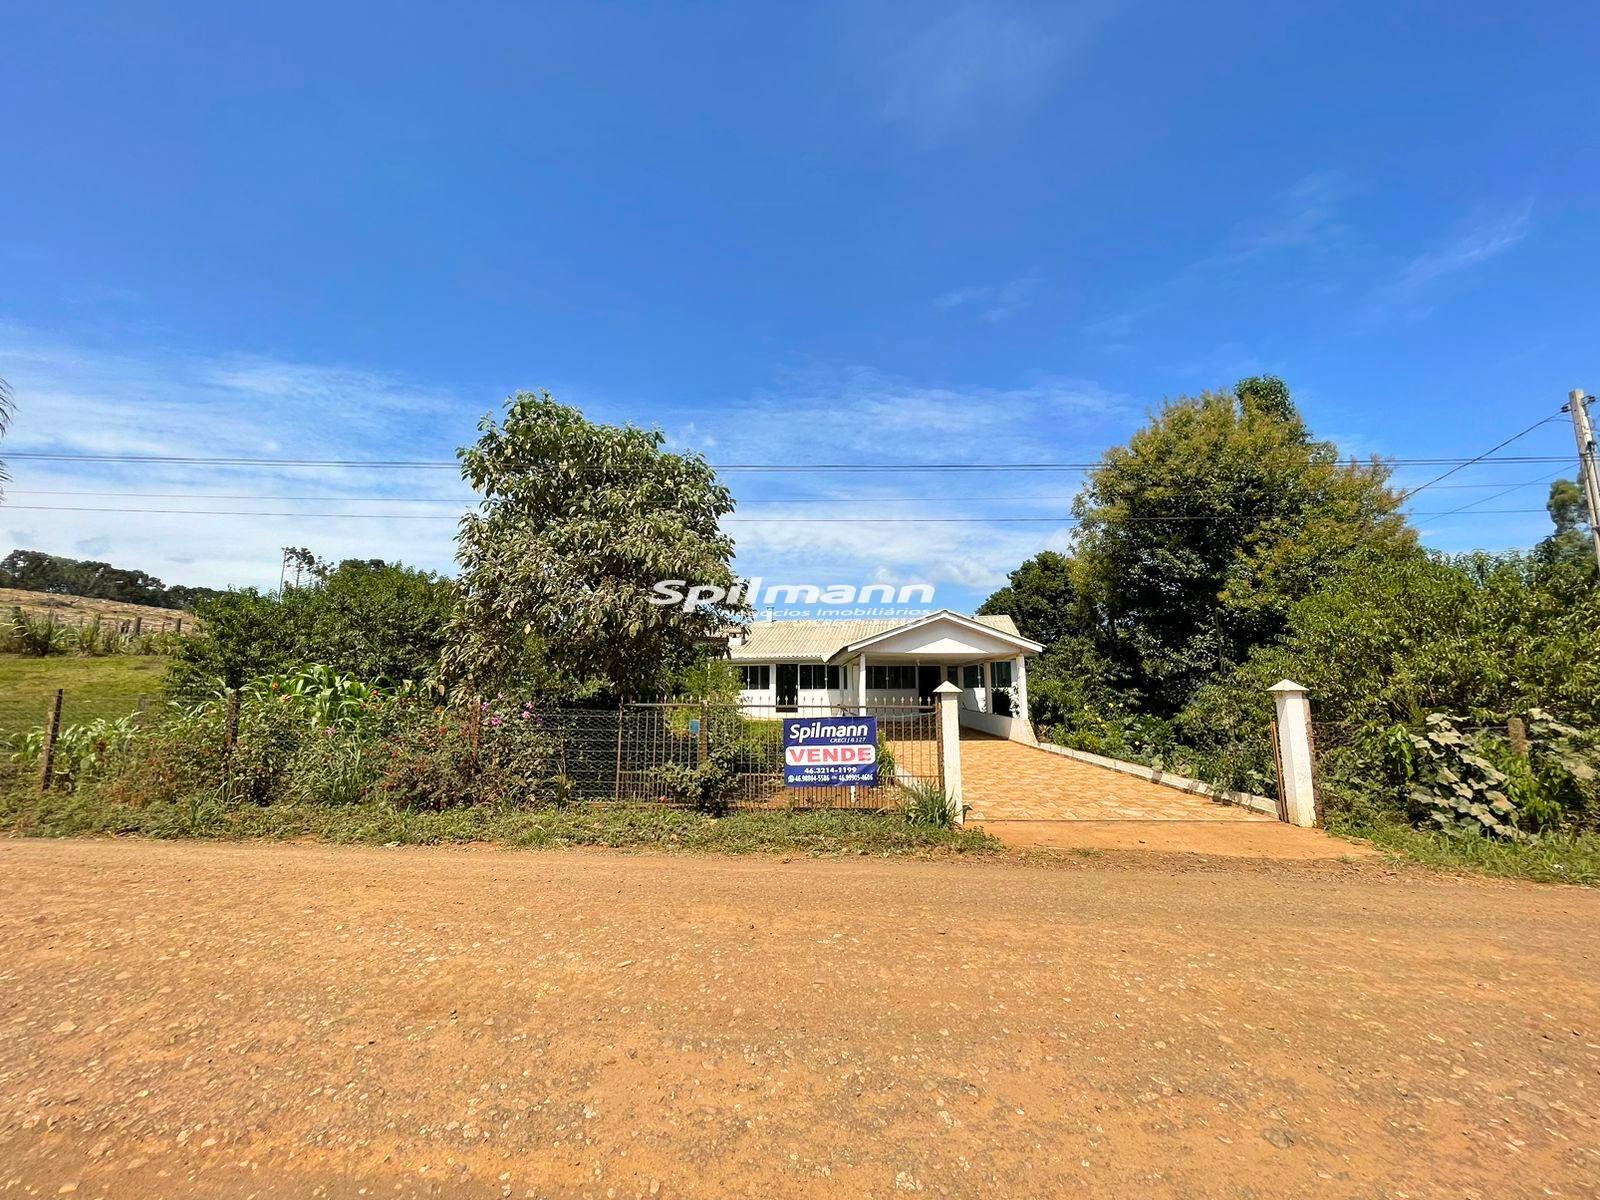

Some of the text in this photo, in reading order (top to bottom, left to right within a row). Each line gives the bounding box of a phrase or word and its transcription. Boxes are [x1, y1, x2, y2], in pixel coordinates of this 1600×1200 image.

[790, 722, 869, 743] Spilmann
[789, 748, 872, 762] VENDE
[804, 766, 857, 774] 46.3214-1199
